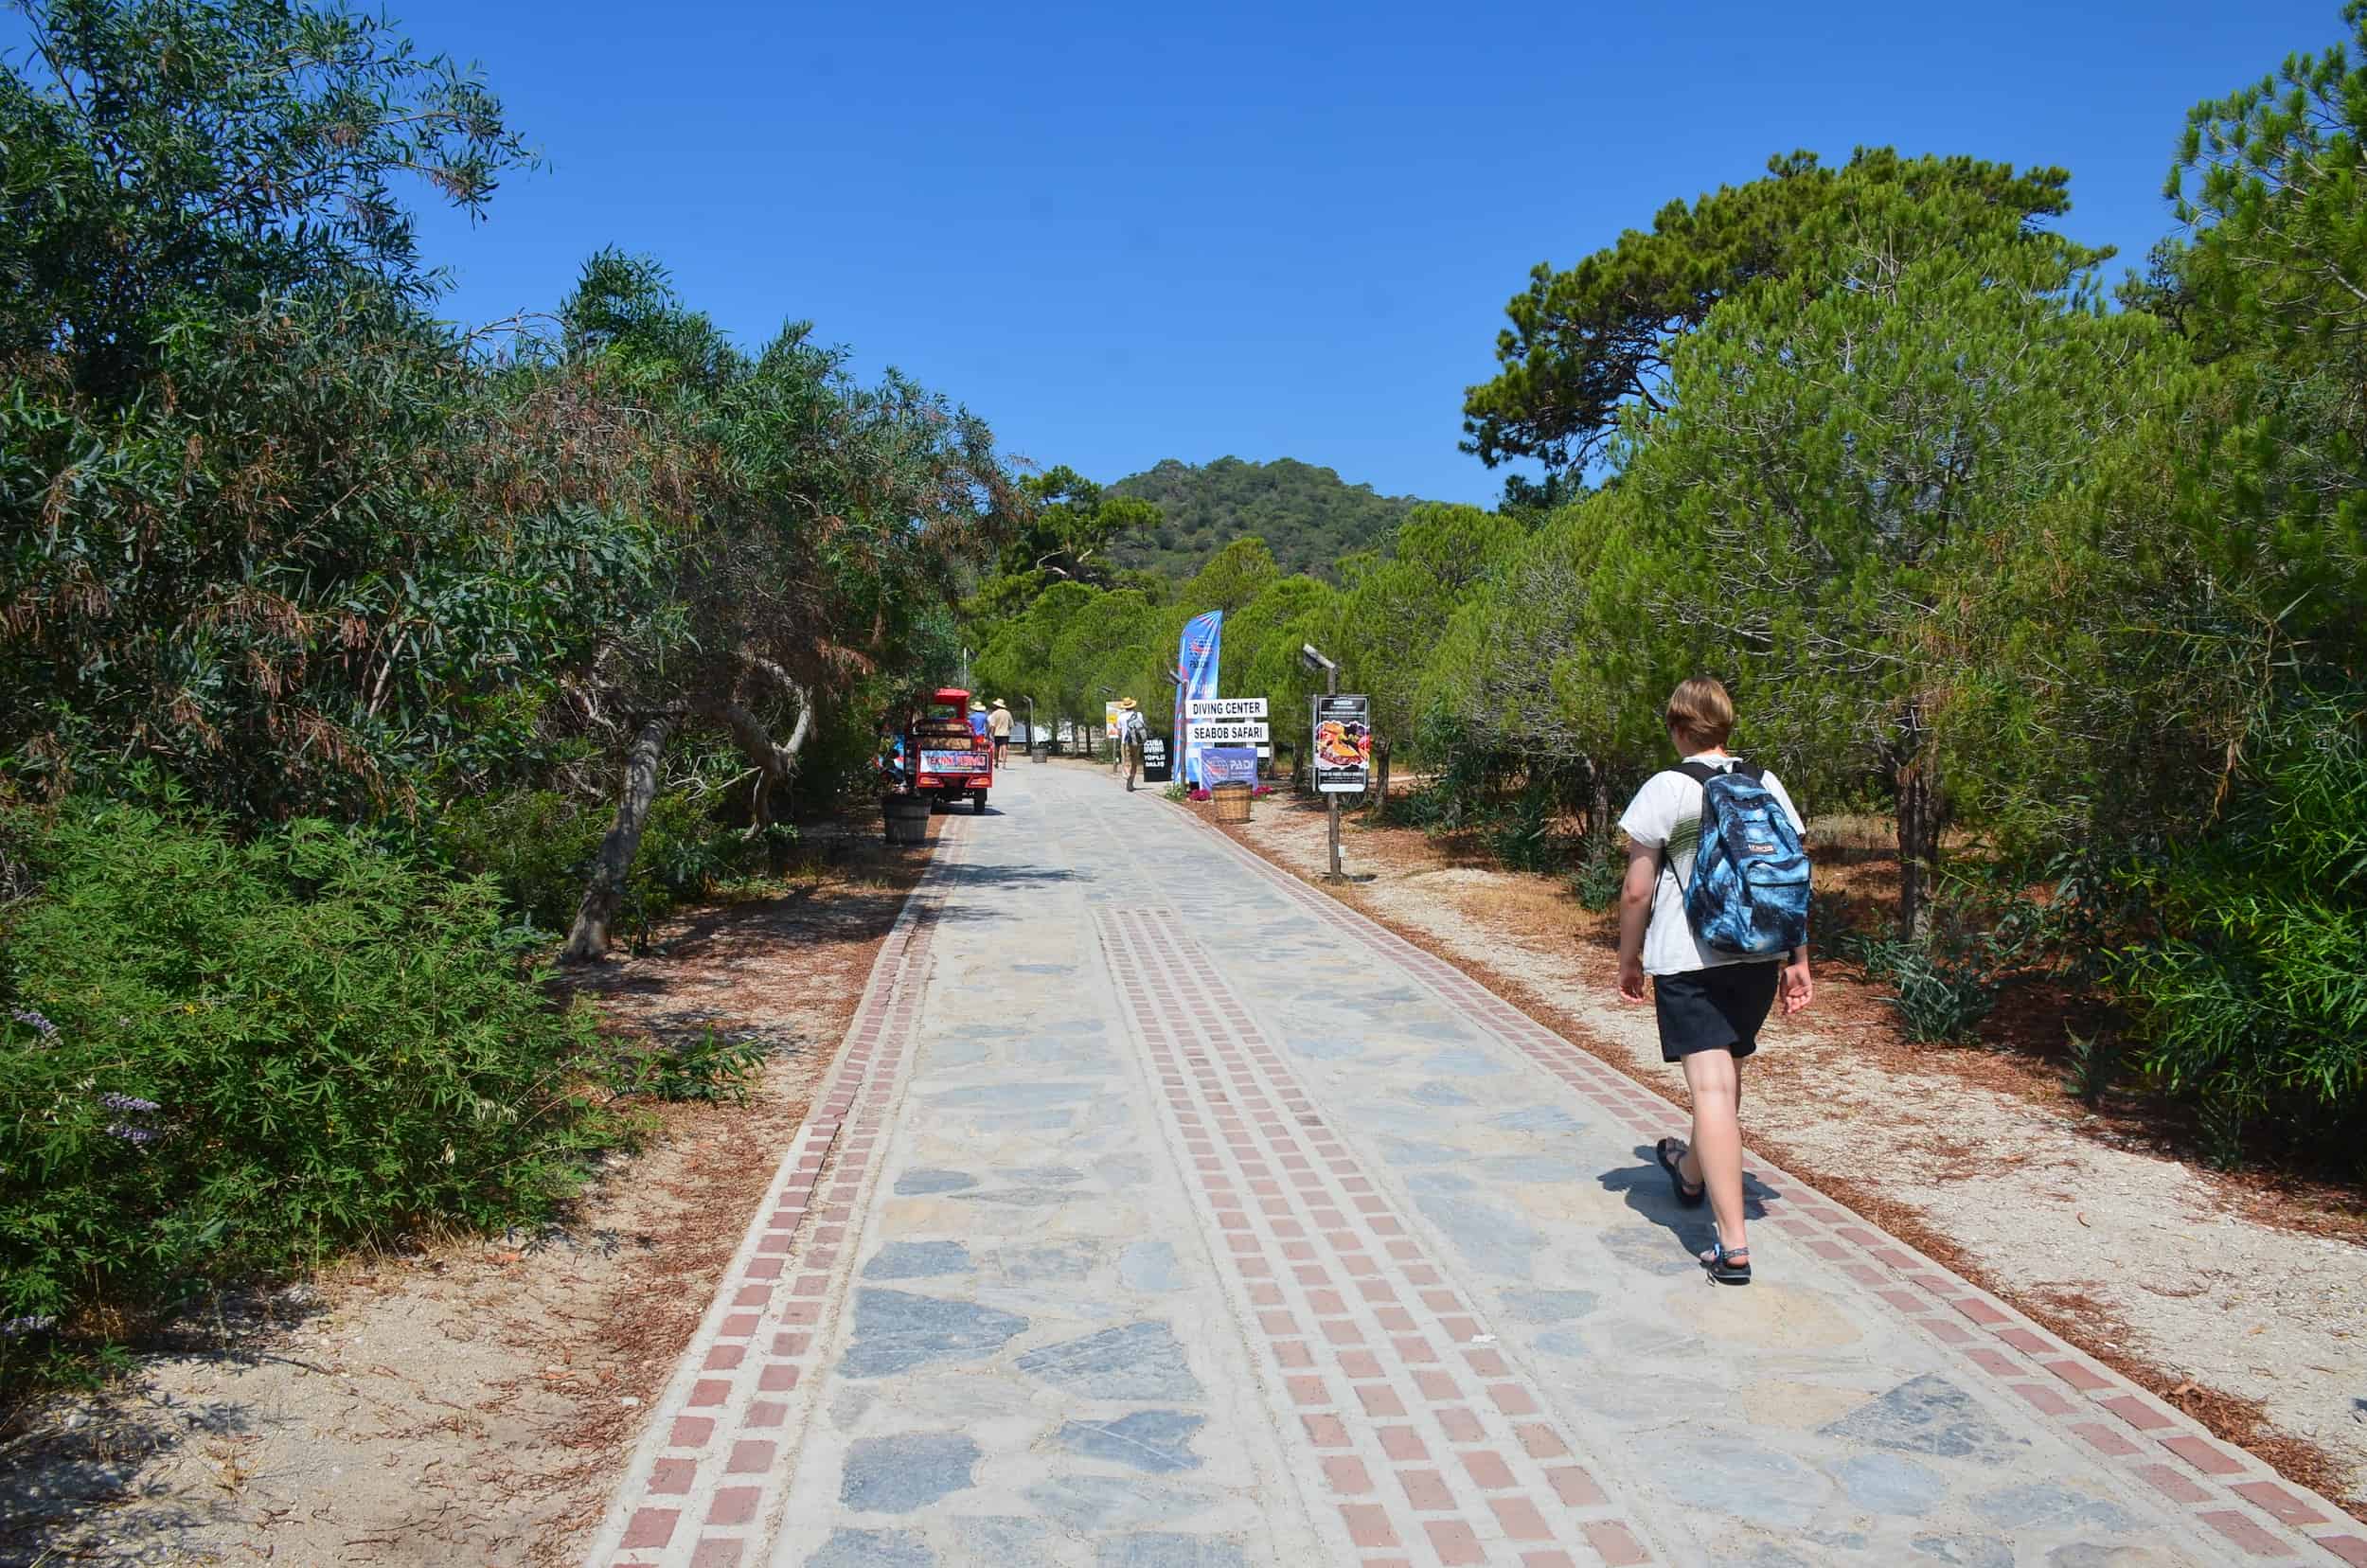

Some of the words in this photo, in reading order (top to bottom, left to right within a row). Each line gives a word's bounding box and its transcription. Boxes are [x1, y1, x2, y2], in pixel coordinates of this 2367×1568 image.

[1193, 704, 1223, 715] DIVING
[1226, 702, 1260, 714] CENTER
[1194, 727, 1229, 739] SEABOB
[1232, 726, 1263, 739] SAFARI
[1230, 759, 1254, 769] PADI
